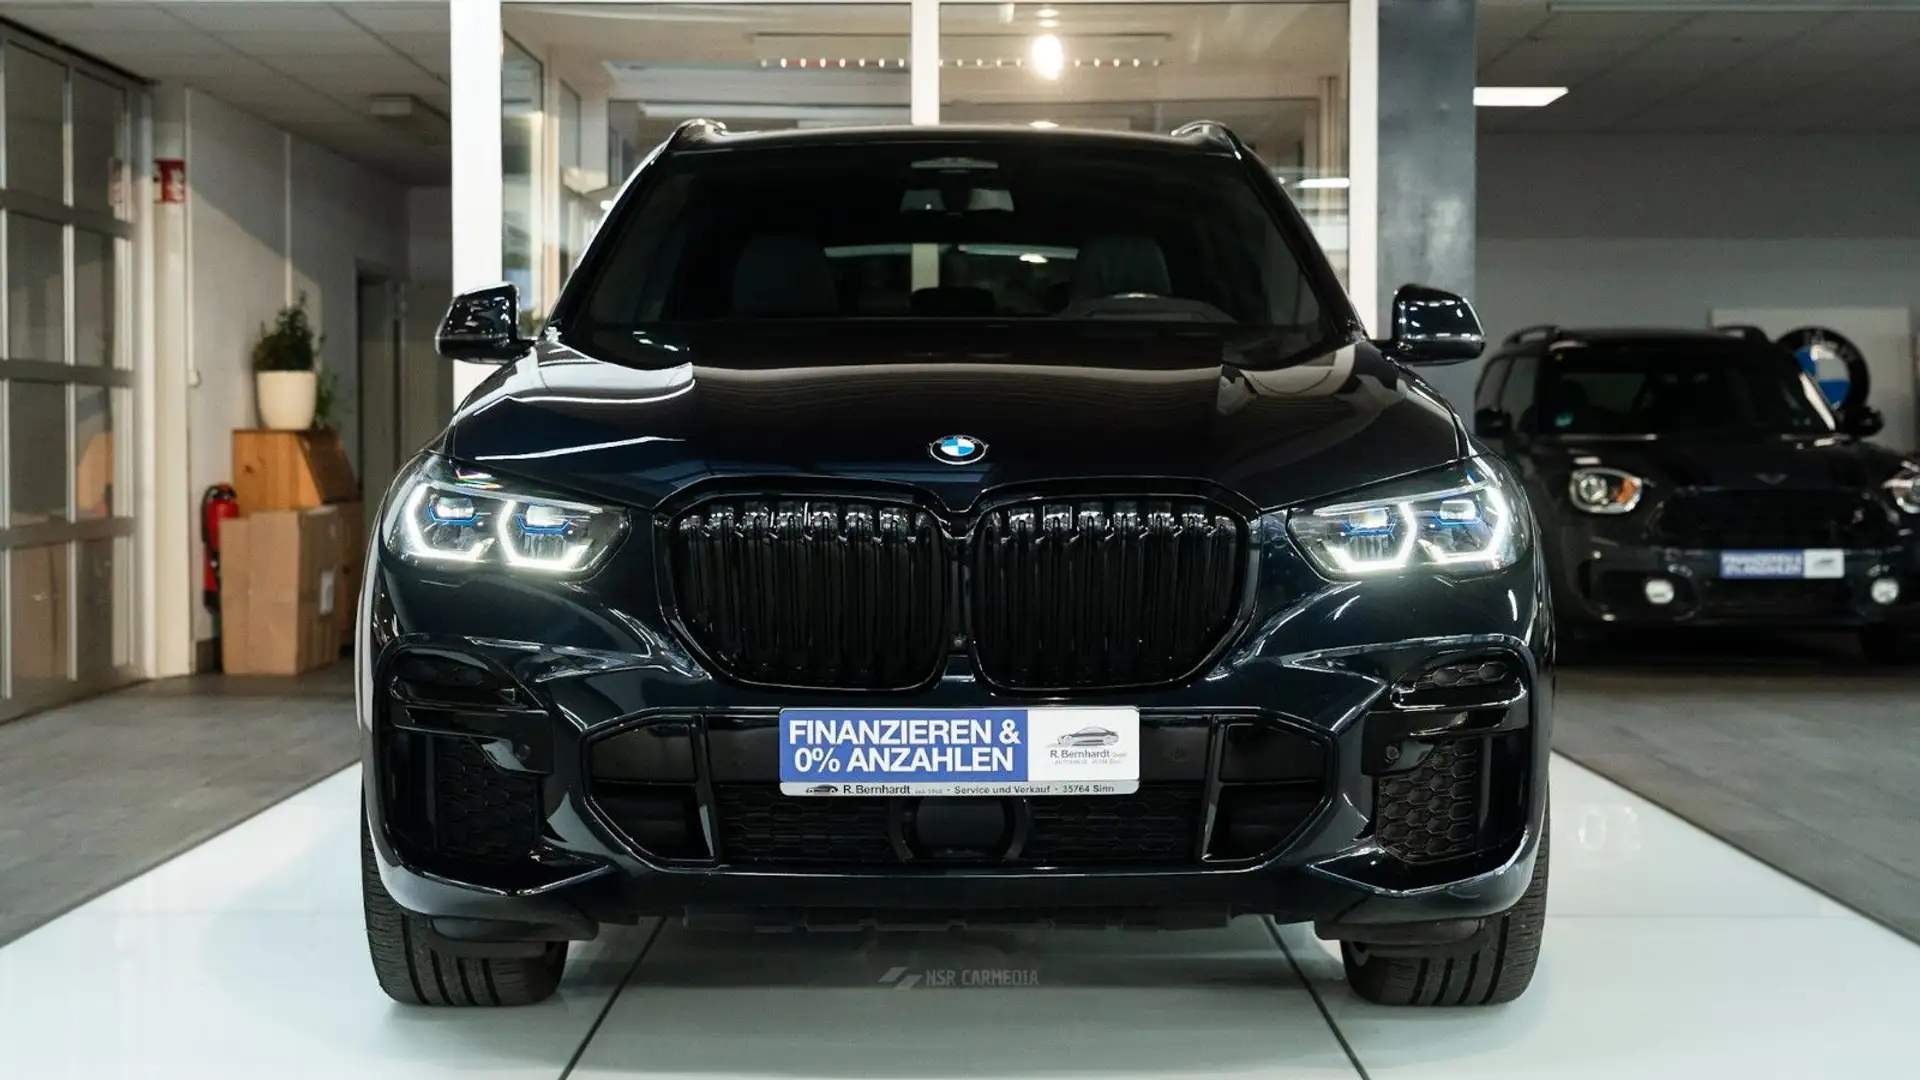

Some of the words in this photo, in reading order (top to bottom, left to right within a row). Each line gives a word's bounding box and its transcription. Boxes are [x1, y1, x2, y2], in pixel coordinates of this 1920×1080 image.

[788, 719, 992, 745] FINANZIEREN
[998, 718, 1022, 745] &
[794, 747, 841, 773] 0%
[846, 746, 1014, 772] ANZAHLEN
[954, 785, 990, 795] Service
[993, 784, 1011, 794] und
[1014, 784, 1051, 794] Verkauf
[1062, 784, 1090, 793] 35764
[1092, 783, 1115, 793] Sinn
